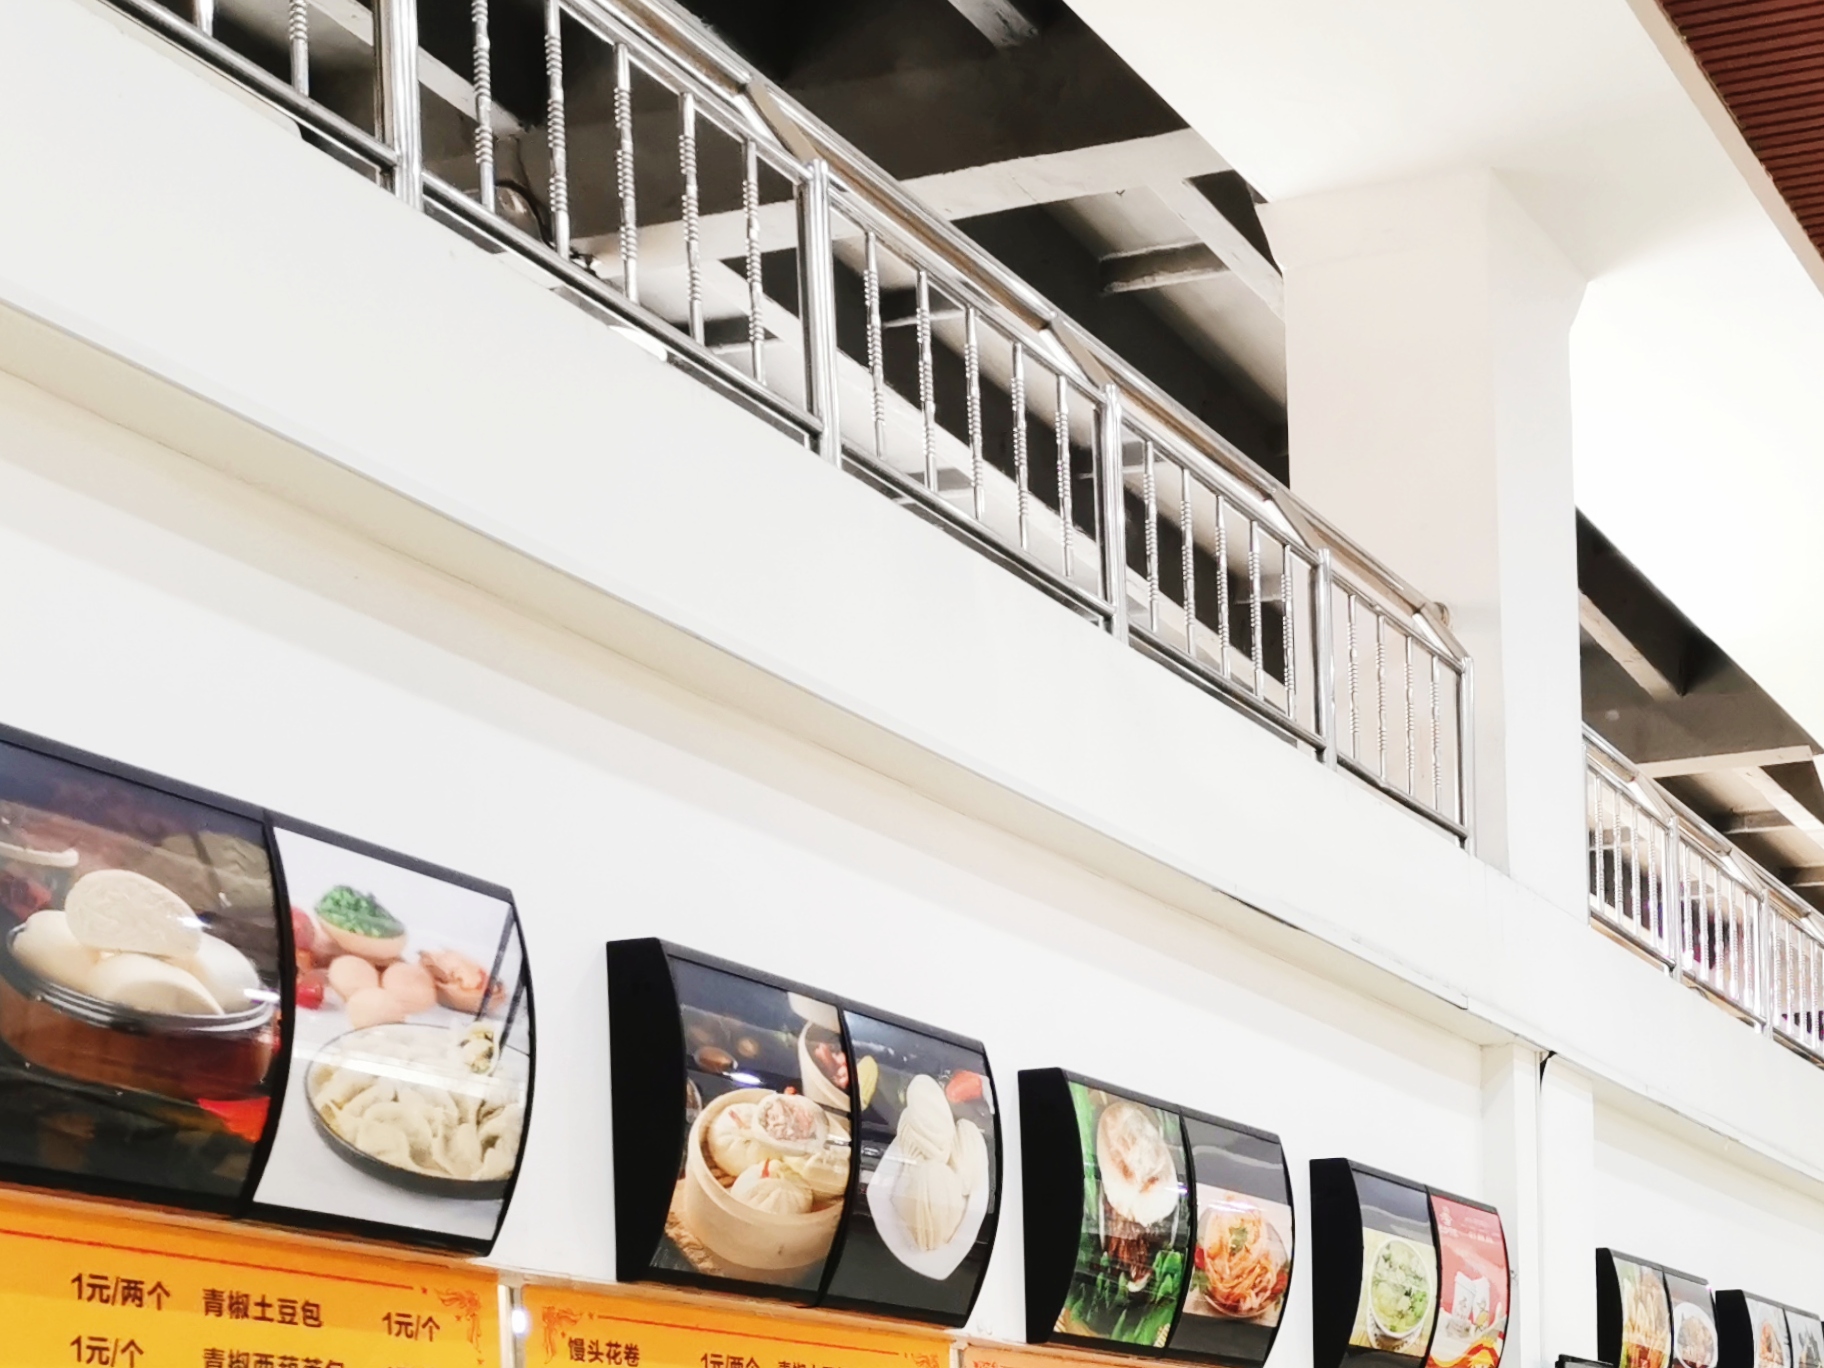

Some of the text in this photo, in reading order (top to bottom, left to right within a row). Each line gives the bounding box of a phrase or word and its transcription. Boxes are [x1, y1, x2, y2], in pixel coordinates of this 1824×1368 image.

[70, 1272, 171, 1312] 1元/两个
[202, 1288, 441, 1342] 青椒土豆包 1元/个
[70, 1336, 145, 1368] 1元/个
[568, 1338, 641, 1368] 馒头花卷
